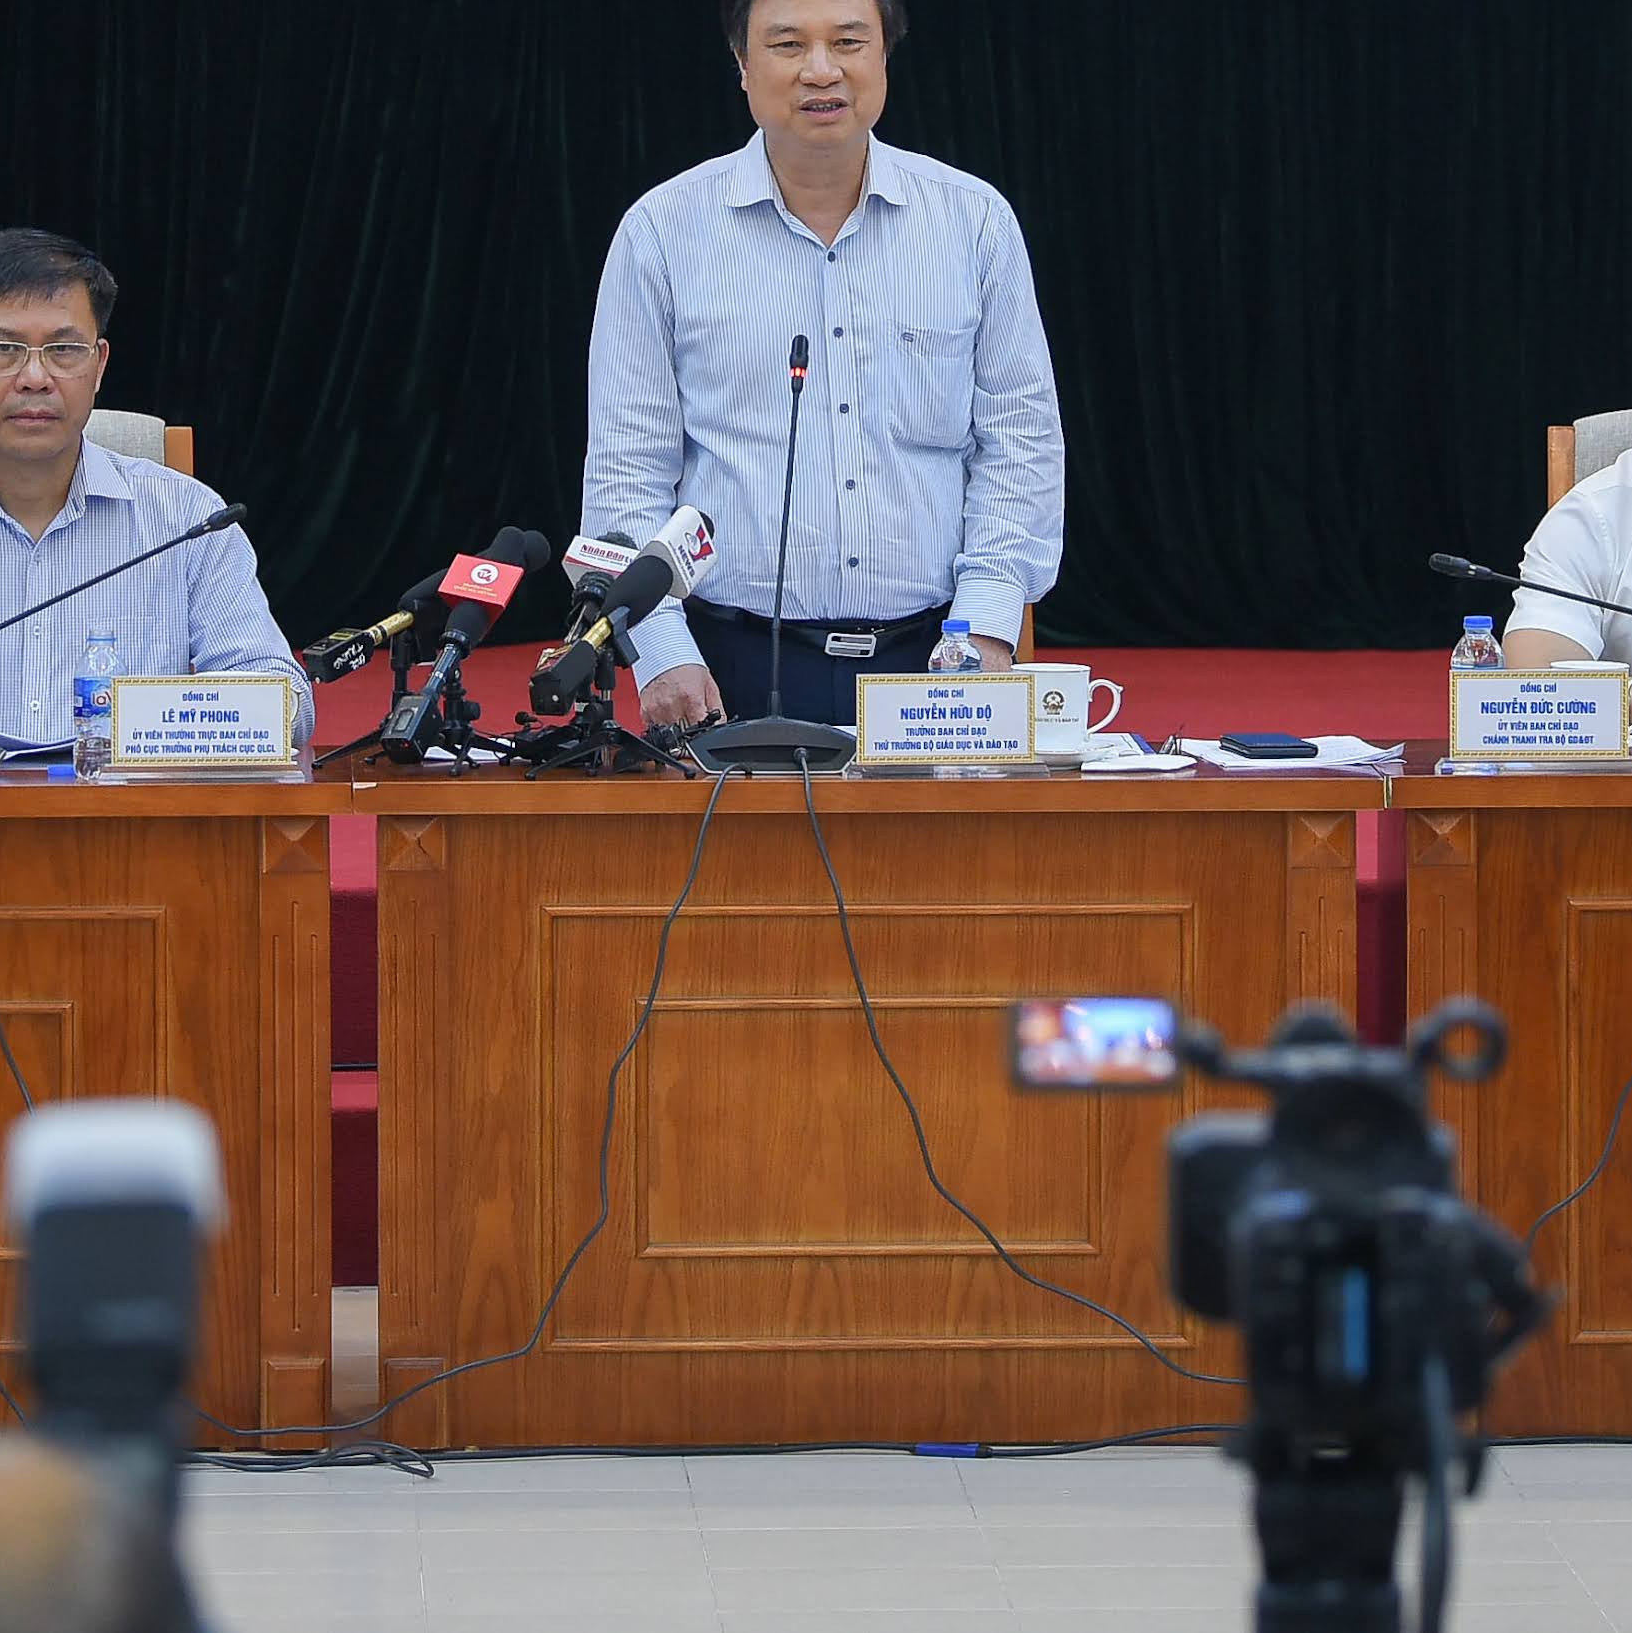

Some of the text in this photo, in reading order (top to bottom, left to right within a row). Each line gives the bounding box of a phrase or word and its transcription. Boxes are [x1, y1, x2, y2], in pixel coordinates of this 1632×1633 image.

[900, 702, 992, 722] NGUYỄN HỮU ĐỘ
[1480, 697, 1596, 714] NGUYỄN ĐỨC CƯỜNG
[162, 708, 240, 723] LÊ MỸ PHONG
